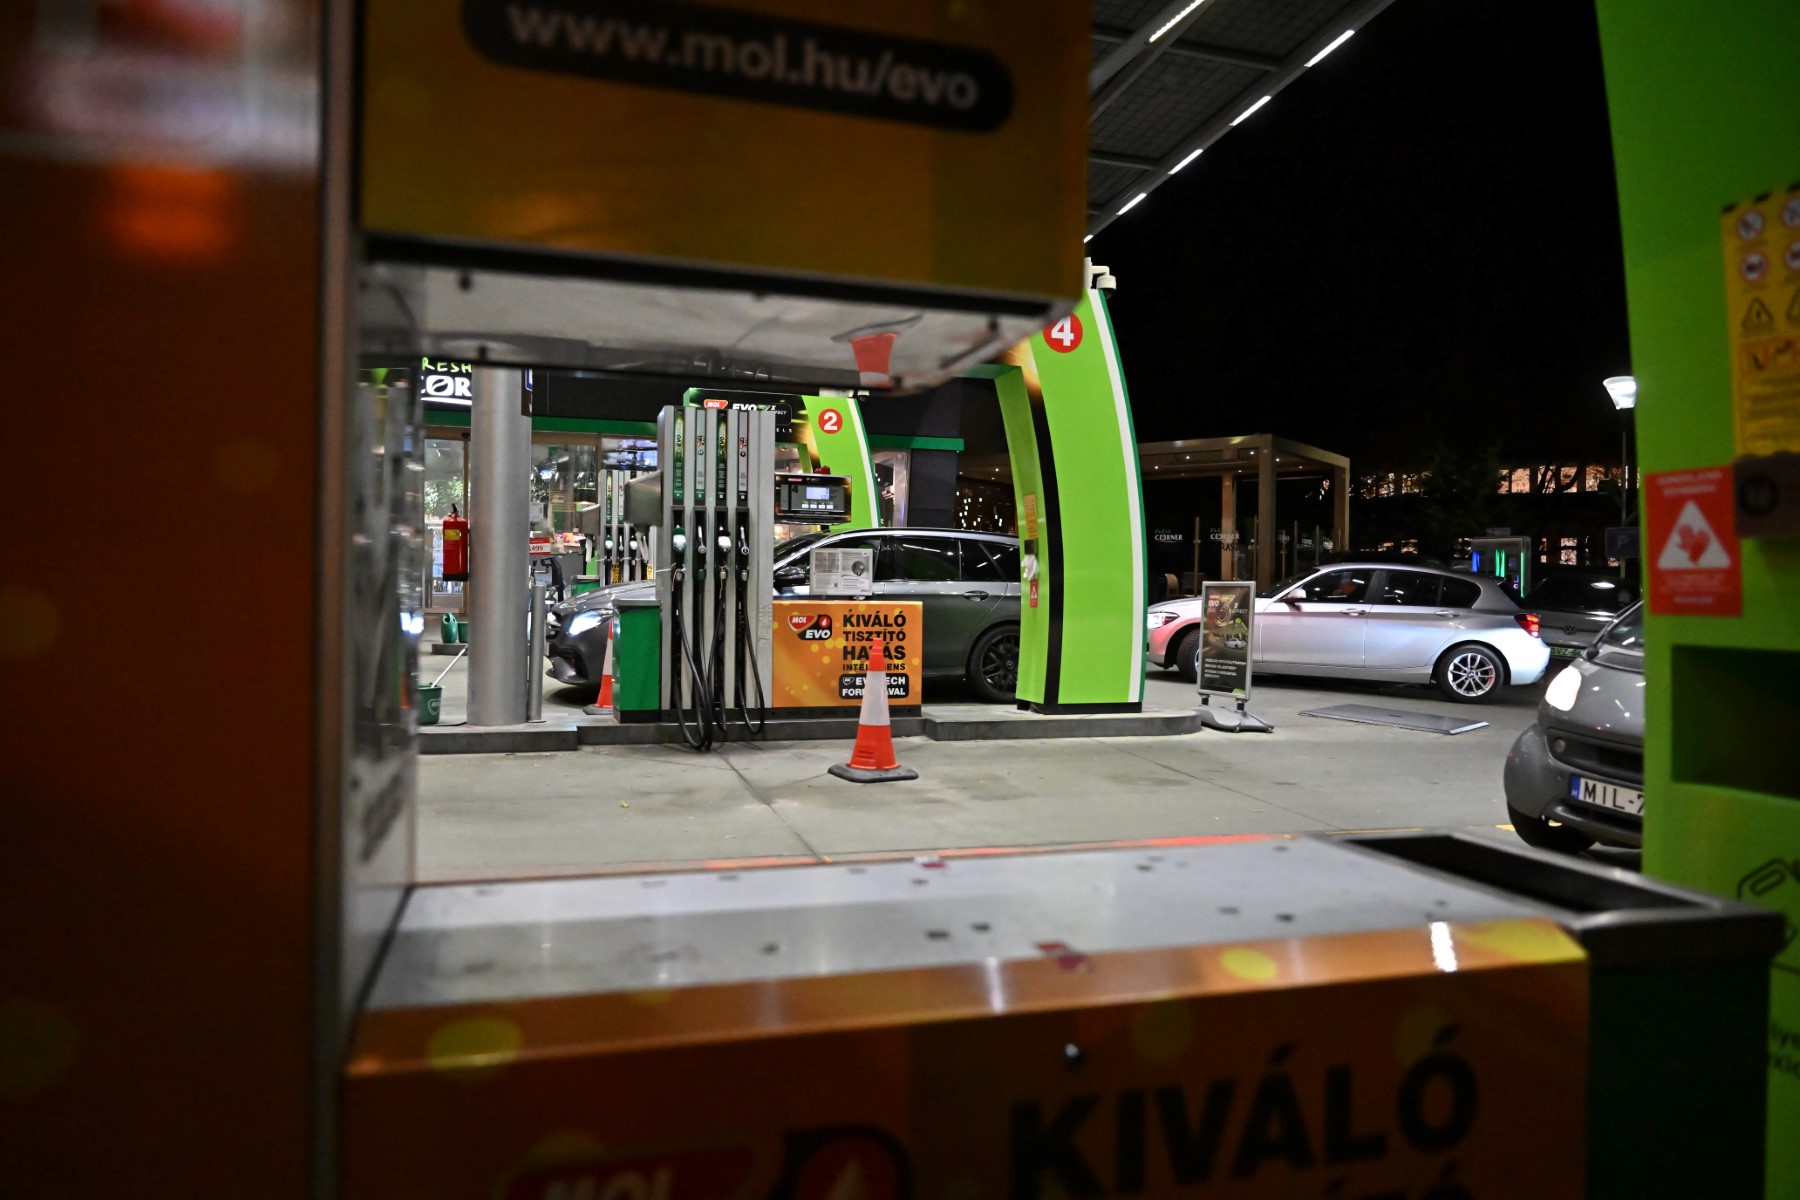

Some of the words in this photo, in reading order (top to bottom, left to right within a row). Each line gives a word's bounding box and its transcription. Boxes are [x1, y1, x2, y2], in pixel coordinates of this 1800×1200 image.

[505, 4, 979, 110] www.mol.hu/evo
[1051, 315, 1075, 346] 4
[732, 403, 757, 411] EVO
[823, 411, 838, 431] 2
[792, 485, 799, 493] 4
[1154, 533, 1183, 541] CORNER
[792, 616, 807, 624] MOL
[843, 610, 906, 627] KIVÁLÓ
[805, 629, 831, 639] EVO
[843, 628, 906, 641] TISZTÍTÓ
[843, 642, 906, 660] HAÁS
[1006, 1022, 1480, 1200] KIVÁLÓ
